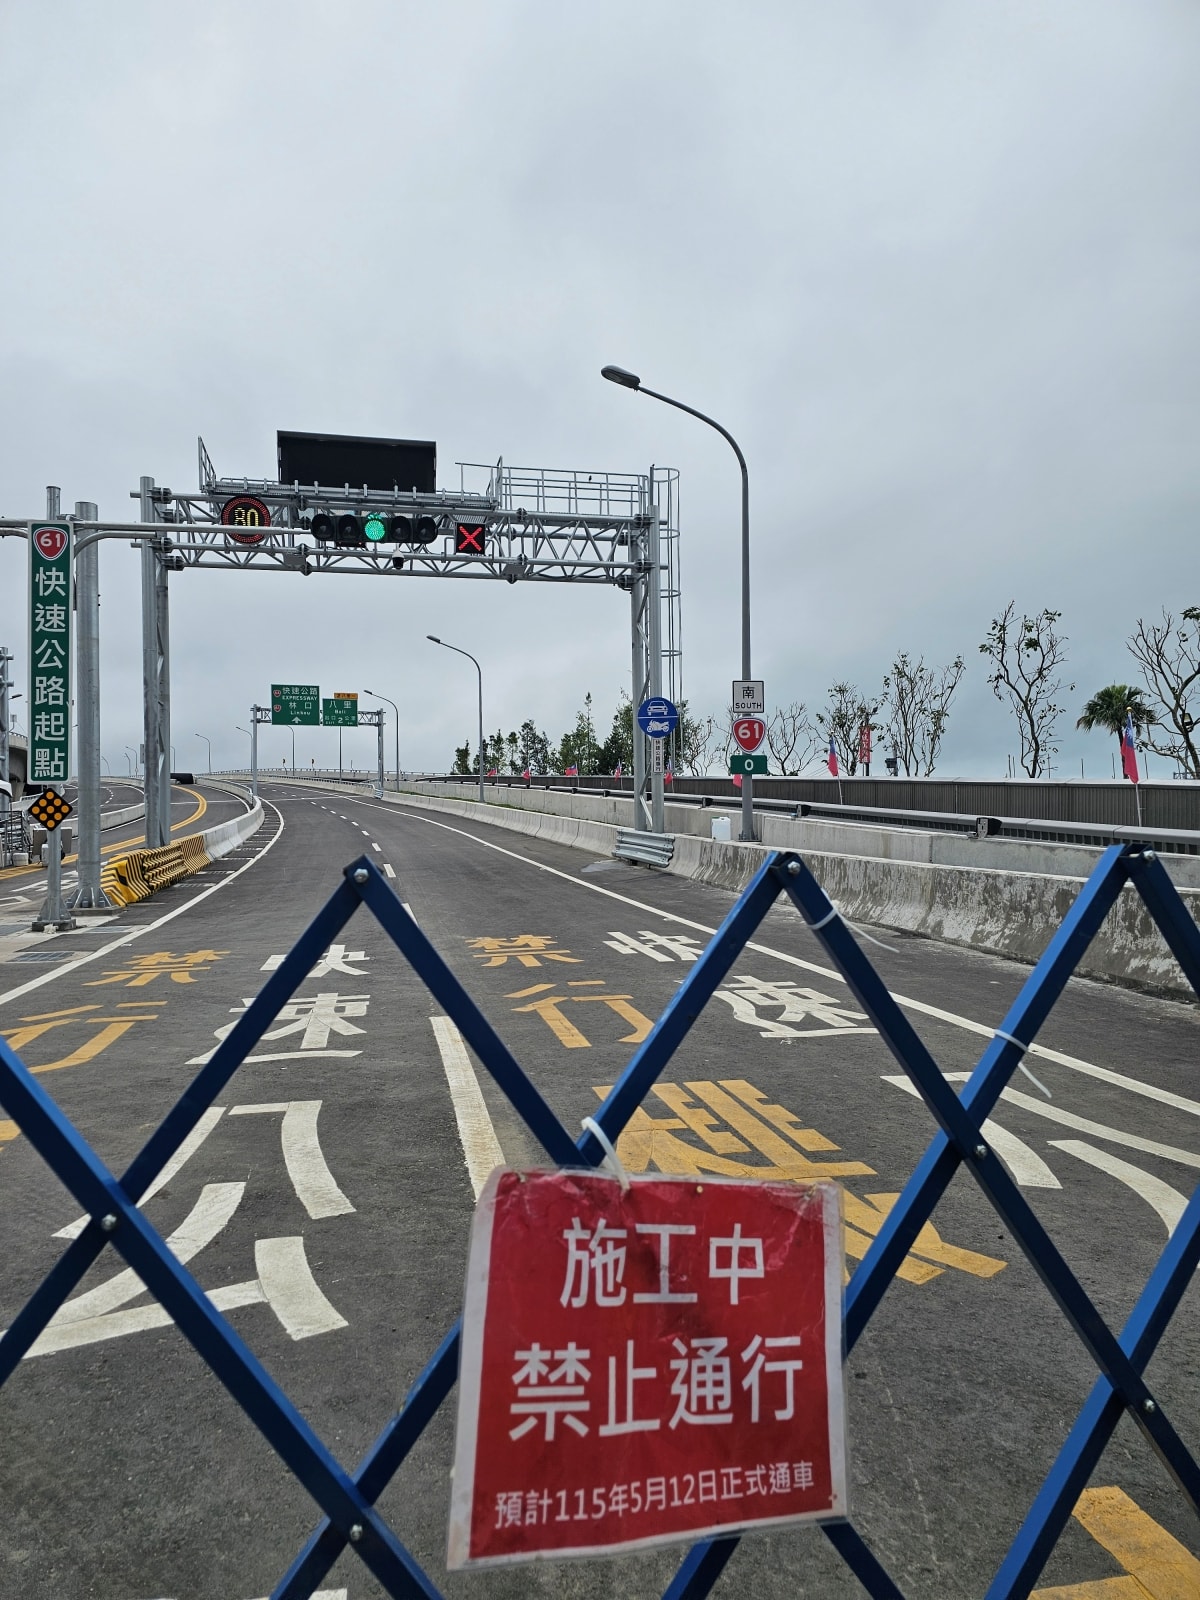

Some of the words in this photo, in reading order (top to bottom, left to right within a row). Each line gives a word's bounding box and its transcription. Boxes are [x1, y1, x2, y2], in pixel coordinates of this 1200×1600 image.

[40, 533, 63, 549] 61
[34, 567, 67, 779] 快速公路起點
[282, 687, 318, 695] 快速公路
[742, 686, 755, 700] 南
[288, 701, 312, 709] 林口
[329, 700, 352, 708] 八里
[738, 723, 760, 739] 61
[744, 759, 754, 771] 0
[559, 1216, 766, 1309] 施工中
[508, 1334, 803, 1442] 禁止通行
[494, 1460, 815, 1531] 預計115年5月12日正式通車
